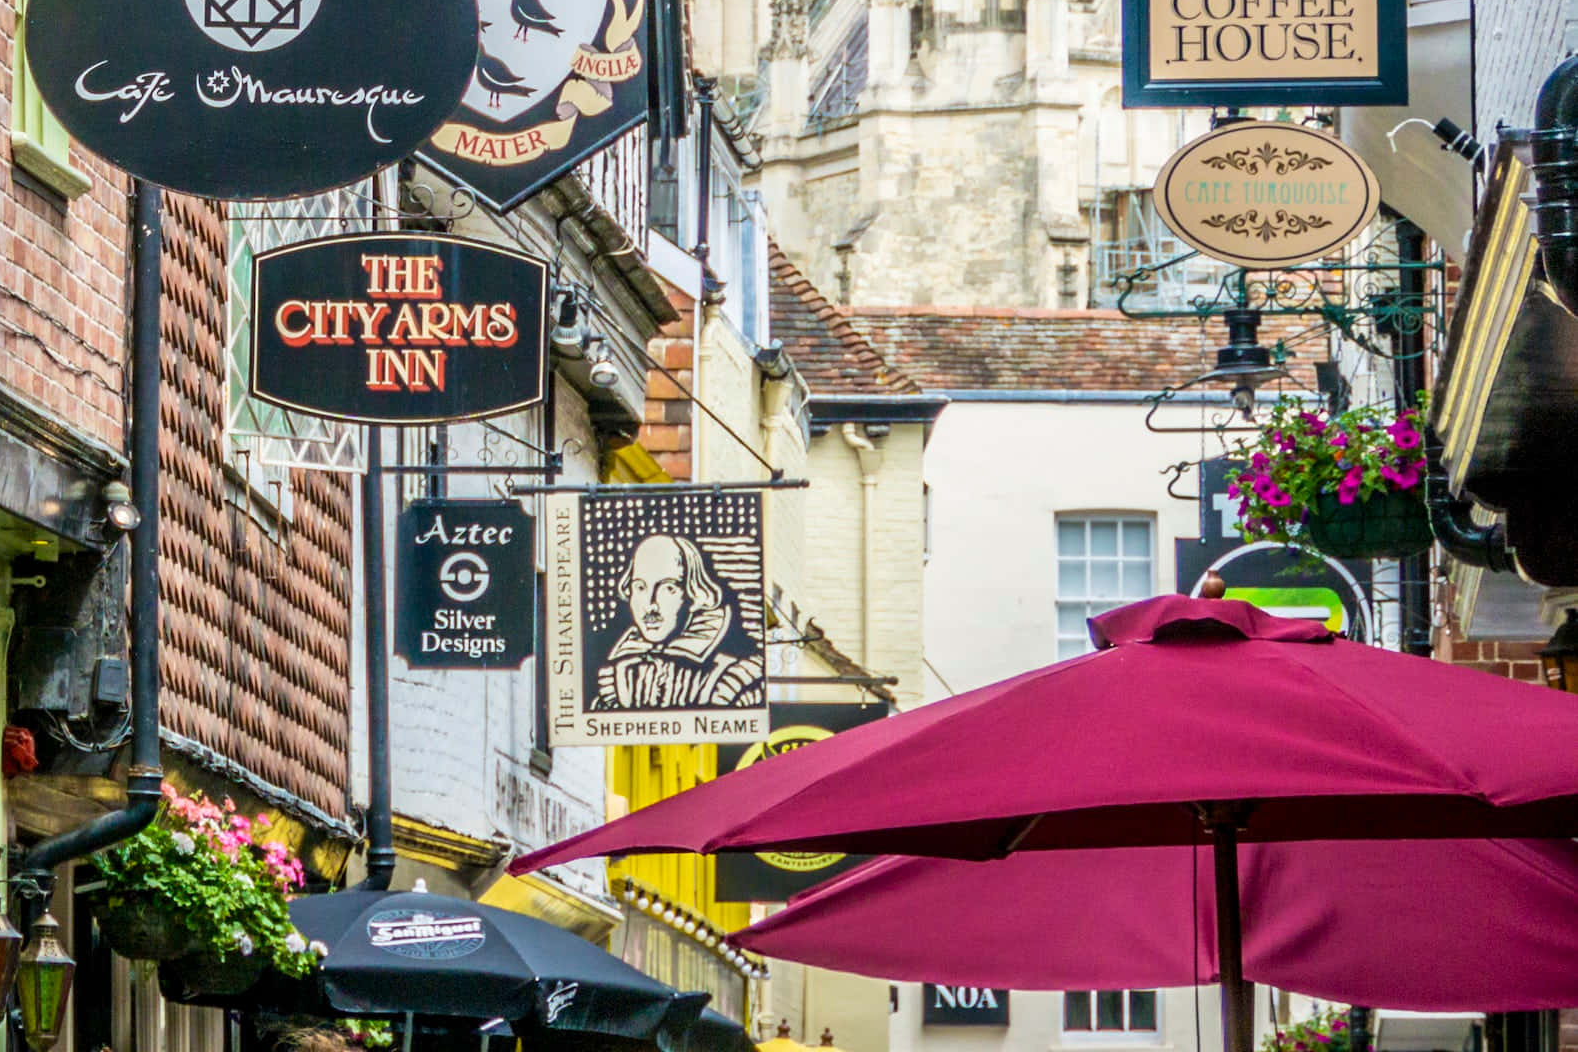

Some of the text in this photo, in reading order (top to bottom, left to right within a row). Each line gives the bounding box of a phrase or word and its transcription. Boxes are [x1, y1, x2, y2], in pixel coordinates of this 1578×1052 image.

[1171, 22, 1355, 63] HOUSE
[74, 60, 175, 123] Café
[454, 129, 547, 159] MATER
[1184, 180, 1349, 205] CAFE TURQUOISE
[361, 252, 443, 299] THE
[275, 300, 518, 347] CITY ARMS
[366, 349, 447, 393] INN
[415, 515, 514, 546] Aztec
[434, 609, 496, 631] Silver
[554, 507, 575, 734] THE SHAKESPEARE
[421, 633, 506, 659] Designs
[585, 713, 760, 737] SHEPHERD NEAME
[933, 984, 999, 1009] NOA
